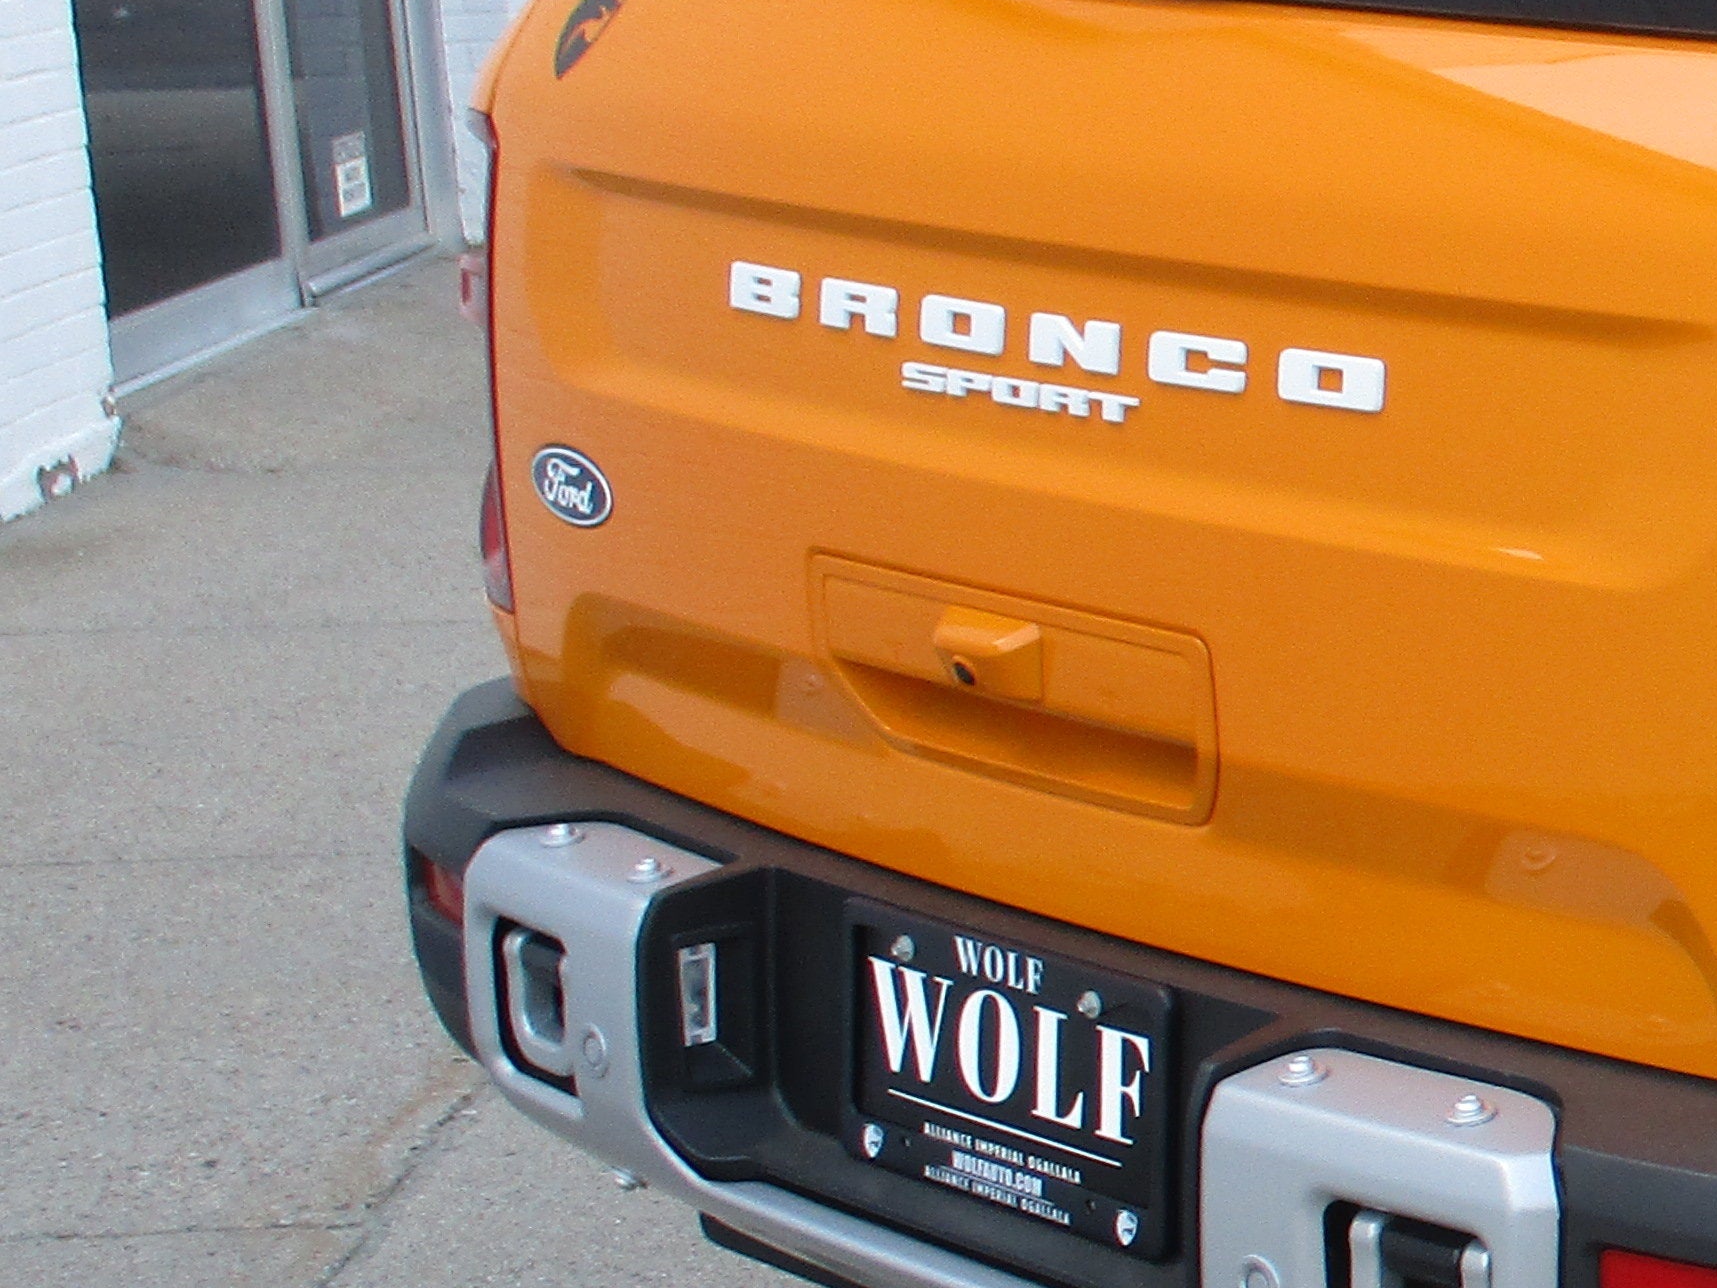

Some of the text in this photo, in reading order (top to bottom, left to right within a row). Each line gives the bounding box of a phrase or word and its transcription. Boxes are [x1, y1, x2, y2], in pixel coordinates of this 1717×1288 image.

[729, 258, 1386, 413] BRONCO
[901, 361, 1140, 423] SPORT
[542, 457, 594, 515] Ford
[954, 935, 1043, 995] WOLF
[867, 955, 1151, 1146] WOLF
[922, 1121, 1082, 1185] ALLIANCE IMPERIAL OGALLALA
[952, 1150, 1042, 1197] WOLFAUTO.COM
